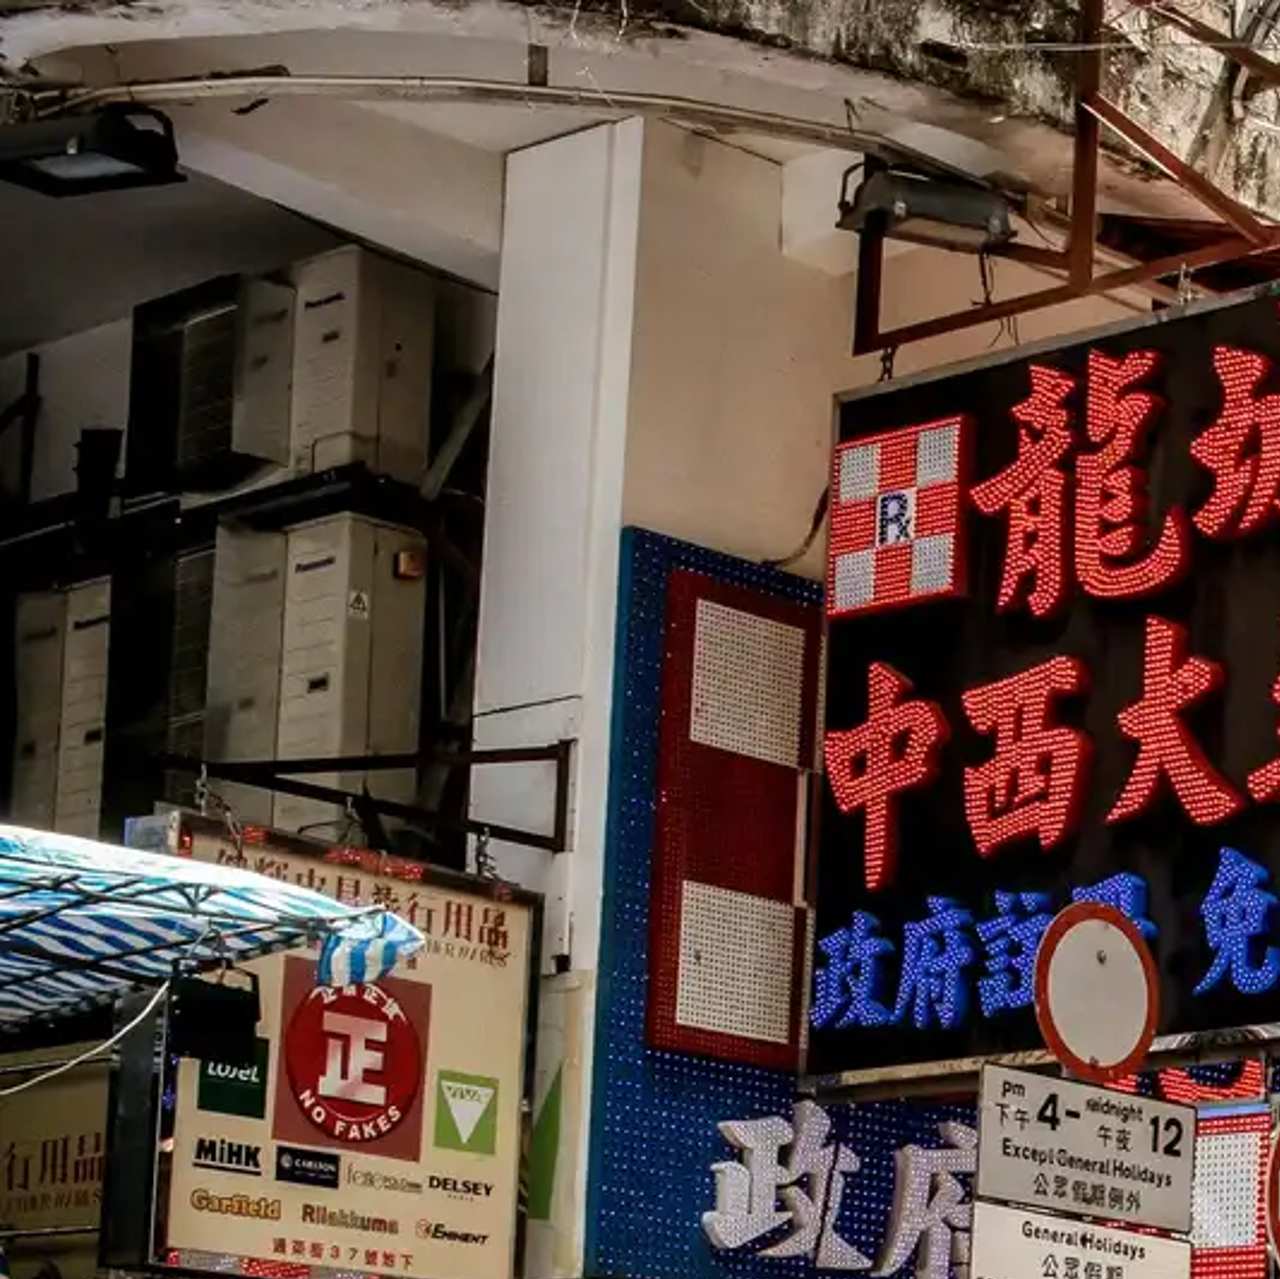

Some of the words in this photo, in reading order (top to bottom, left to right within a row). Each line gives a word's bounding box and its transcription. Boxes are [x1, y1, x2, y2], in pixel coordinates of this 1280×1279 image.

[1001, 1079, 1025, 1099] pm
[299, 1088, 326, 1124] NO
[334, 1104, 402, 1142] FAKES
[995, 1101, 1032, 1131] 下午
[1096, 1123, 1133, 1153] 午夜
[1150, 1115, 1185, 1158] 12
[1002, 1138, 1055, 1166] Except
[1056, 1147, 1111, 1178] General
[1112, 1159, 1173, 1189] Holidays
[191, 1187, 282, 1221] Garfield
[428, 1175, 494, 1197] DELSEY
[1022, 1220, 1079, 1248] General
[1081, 1230, 1147, 1261] Holidays
